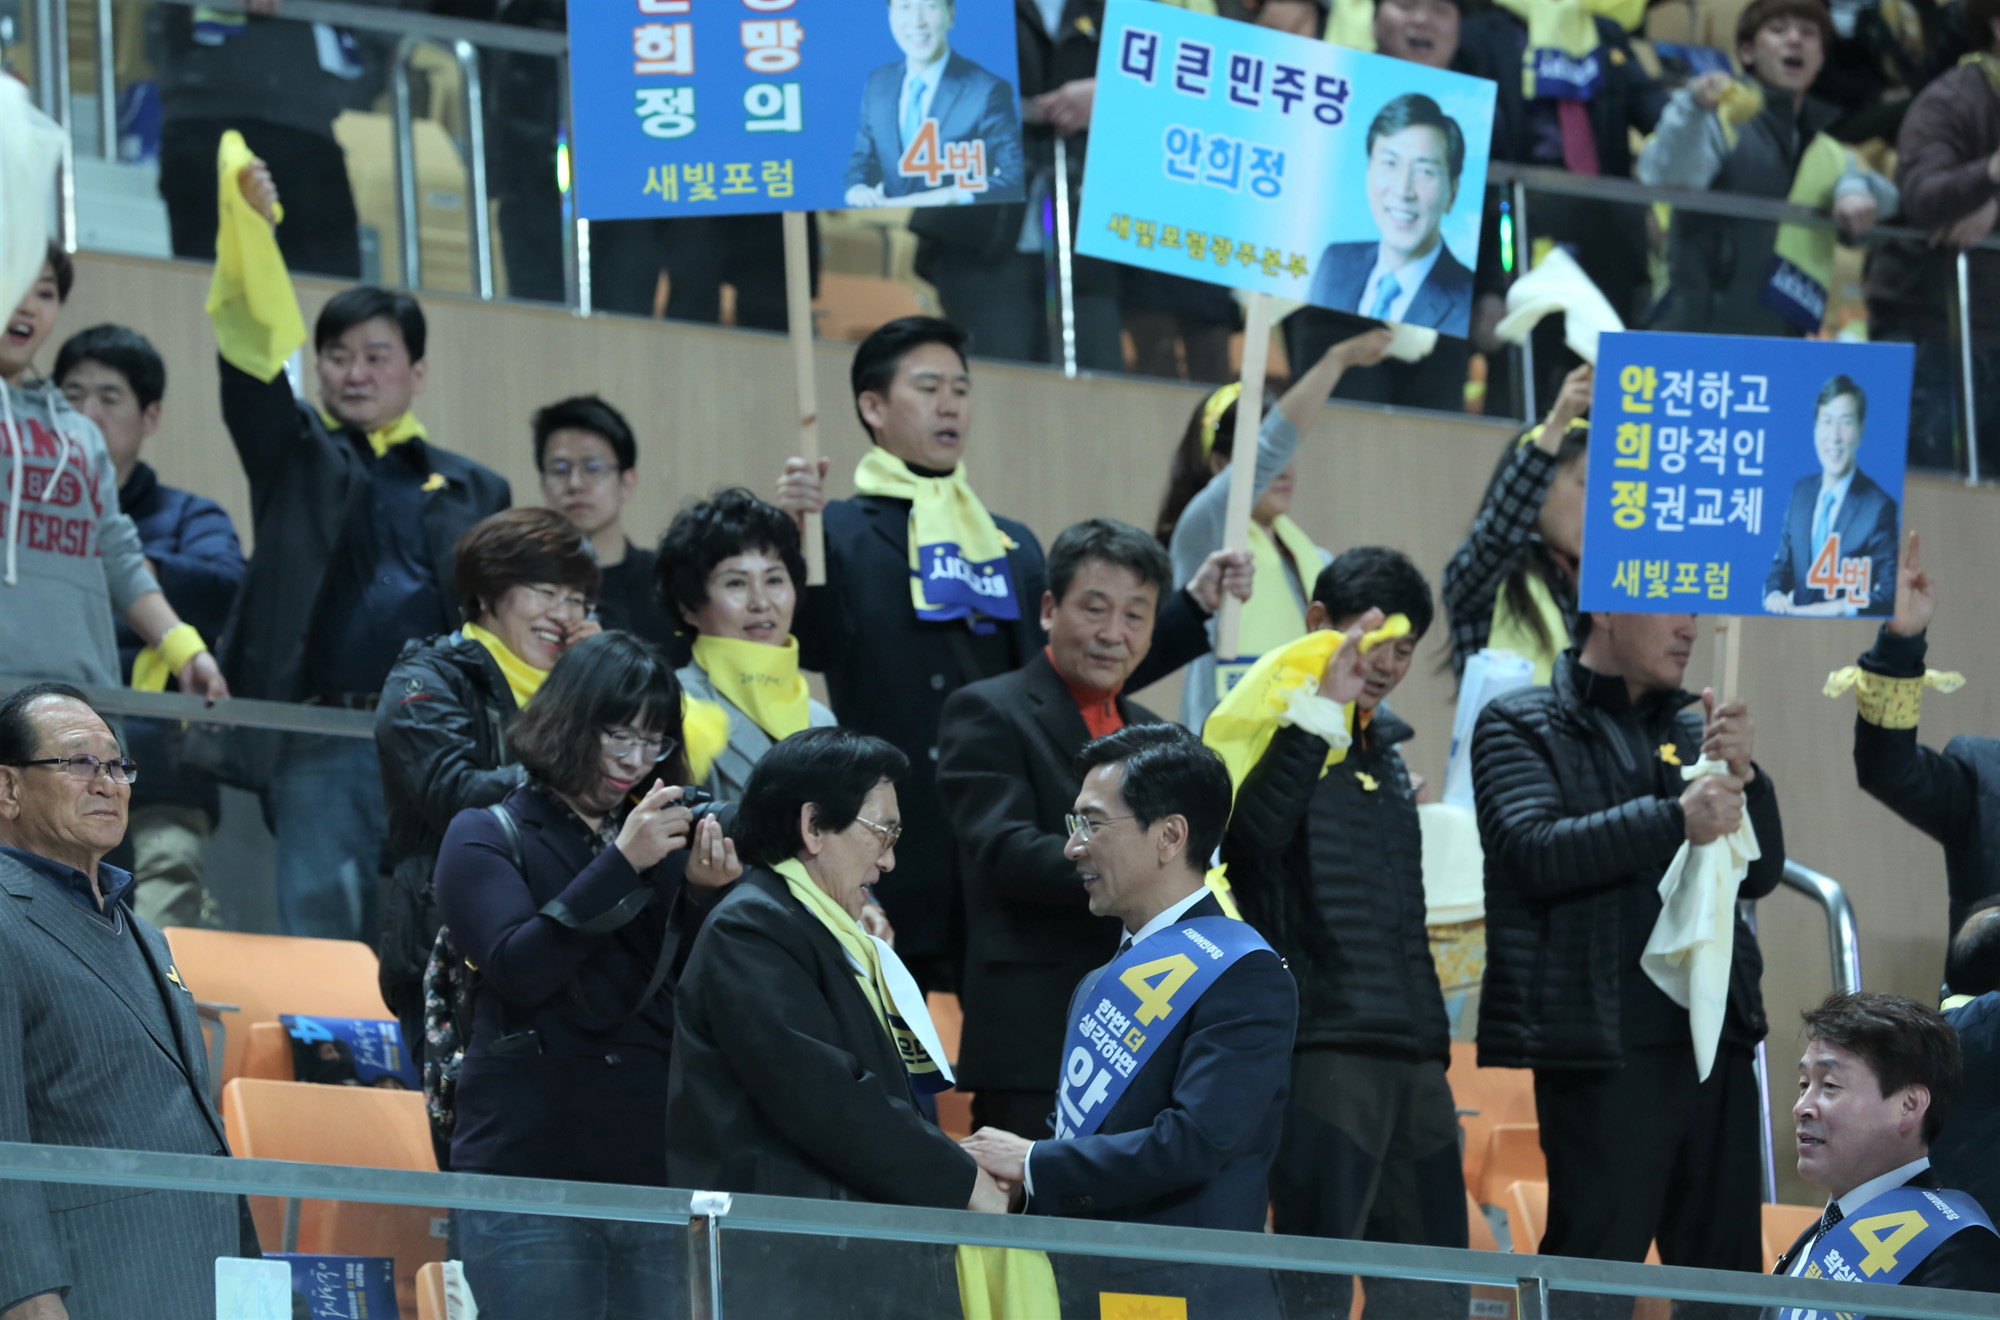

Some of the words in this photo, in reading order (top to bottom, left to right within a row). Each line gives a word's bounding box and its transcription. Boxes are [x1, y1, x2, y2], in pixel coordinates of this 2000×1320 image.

[1119, 29, 1158, 85] 더
[1176, 42, 1211, 95] 큰
[1229, 55, 1350, 126] 민주당
[643, 160, 794, 202] 새빛포럼
[900, 118, 987, 192] 4번
[1165, 128, 1286, 198] 안희정
[1620, 365, 1770, 419] 안전하고
[1614, 422, 1765, 476] 희망적인
[1611, 481, 1763, 535] 정권교체
[1612, 559, 1731, 600] 새빛포럼
[1807, 533, 1872, 608] 4번
[1182, 927, 1226, 960] 더불어민주당
[1119, 953, 1199, 1027] 4
[1079, 1013, 1138, 1079] 생각하면
[1094, 998, 1131, 1038] 한번
[1123, 1027, 1147, 1053] 더
[1824, 1249, 1863, 1283] 확실
[1849, 1210, 1929, 1278] 4
